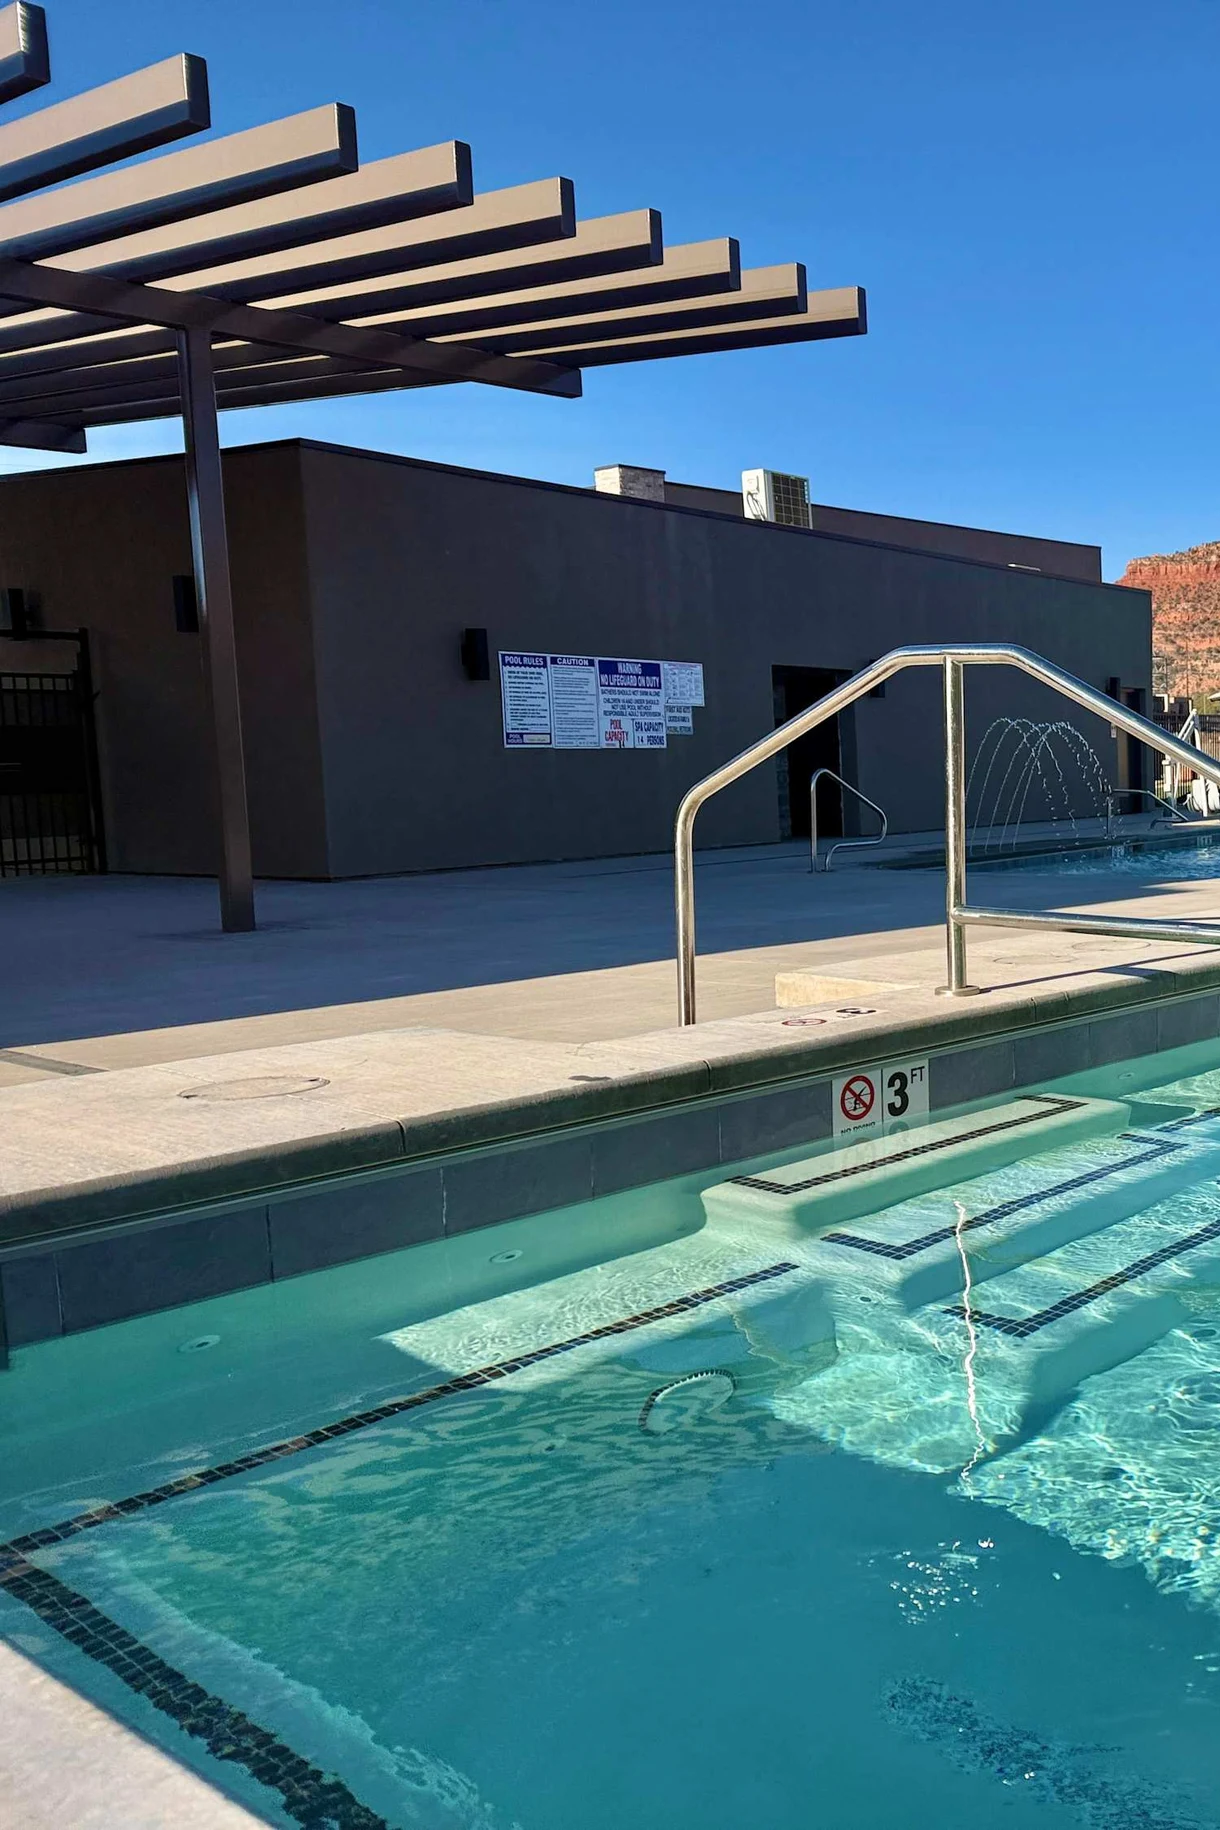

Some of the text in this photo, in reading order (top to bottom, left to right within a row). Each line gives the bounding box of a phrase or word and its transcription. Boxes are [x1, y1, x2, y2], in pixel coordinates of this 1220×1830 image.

[505, 656, 544, 666] POOL RULES
[557, 658, 589, 666] CAUTION
[617, 662, 642, 674] WARNING
[600, 674, 660, 688] NO LIFEGUARD ON DUTY
[610, 719, 622, 730] POOL
[634, 721, 643, 731] SPA
[644, 721, 664, 732] CAPACITY
[605, 730, 629, 742] CAPACITY
[646, 735, 665, 746] PERSONS
[887, 1066, 925, 1117] 3 FT
